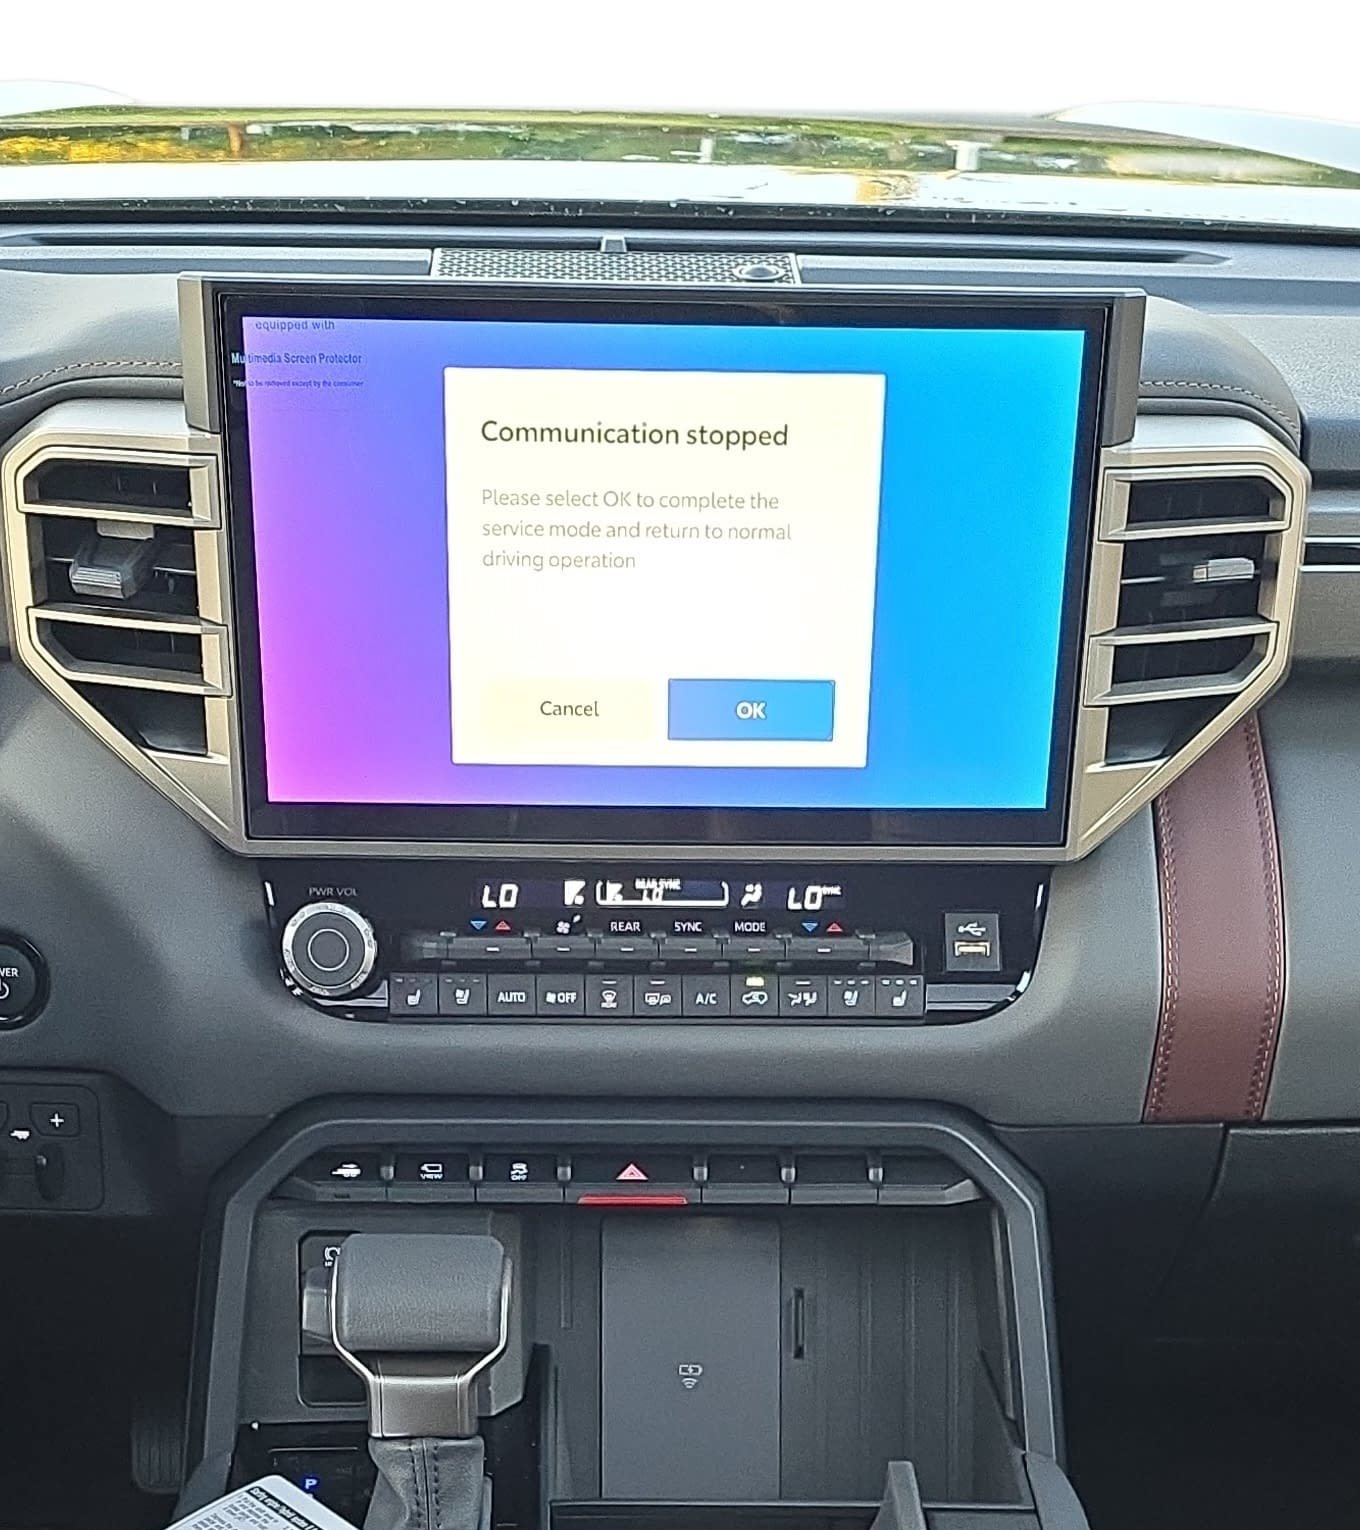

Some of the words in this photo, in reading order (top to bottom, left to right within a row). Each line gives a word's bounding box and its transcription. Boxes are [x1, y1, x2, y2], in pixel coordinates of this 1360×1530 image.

[255, 320, 308, 332] equipped
[312, 320, 335, 330] with
[231, 352, 282, 364] Mutimedia
[284, 352, 317, 364] Screen
[318, 352, 362, 364] Protector
[481, 420, 680, 445] Communication
[686, 423, 789, 451] stopped
[481, 488, 541, 507] Please
[545, 489, 599, 508] select
[602, 490, 632, 508] OK
[636, 492, 655, 508] to
[659, 491, 746, 513] complete
[749, 492, 780, 510] the
[481, 520, 545, 538] service
[548, 520, 602, 538] mode
[605, 521, 641, 539] and
[645, 522, 701, 540] return
[704, 523, 724, 540] to
[728, 523, 793, 541] normal
[481, 549, 544, 572] driving
[548, 551, 636, 571] operation
[539, 700, 600, 718] Cancel
[734, 700, 768, 720] OK
[308, 886, 335, 897] PWR
[336, 886, 358, 897] VOL
[609, 920, 641, 933] REAR
[673, 920, 703, 933] SYNC
[733, 920, 767, 933] MODE
[497, 990, 527, 1004] AUTO
[556, 991, 578, 1004] OFF
[695, 992, 718, 1005] A/C
[304, 1478, 318, 1491] P
